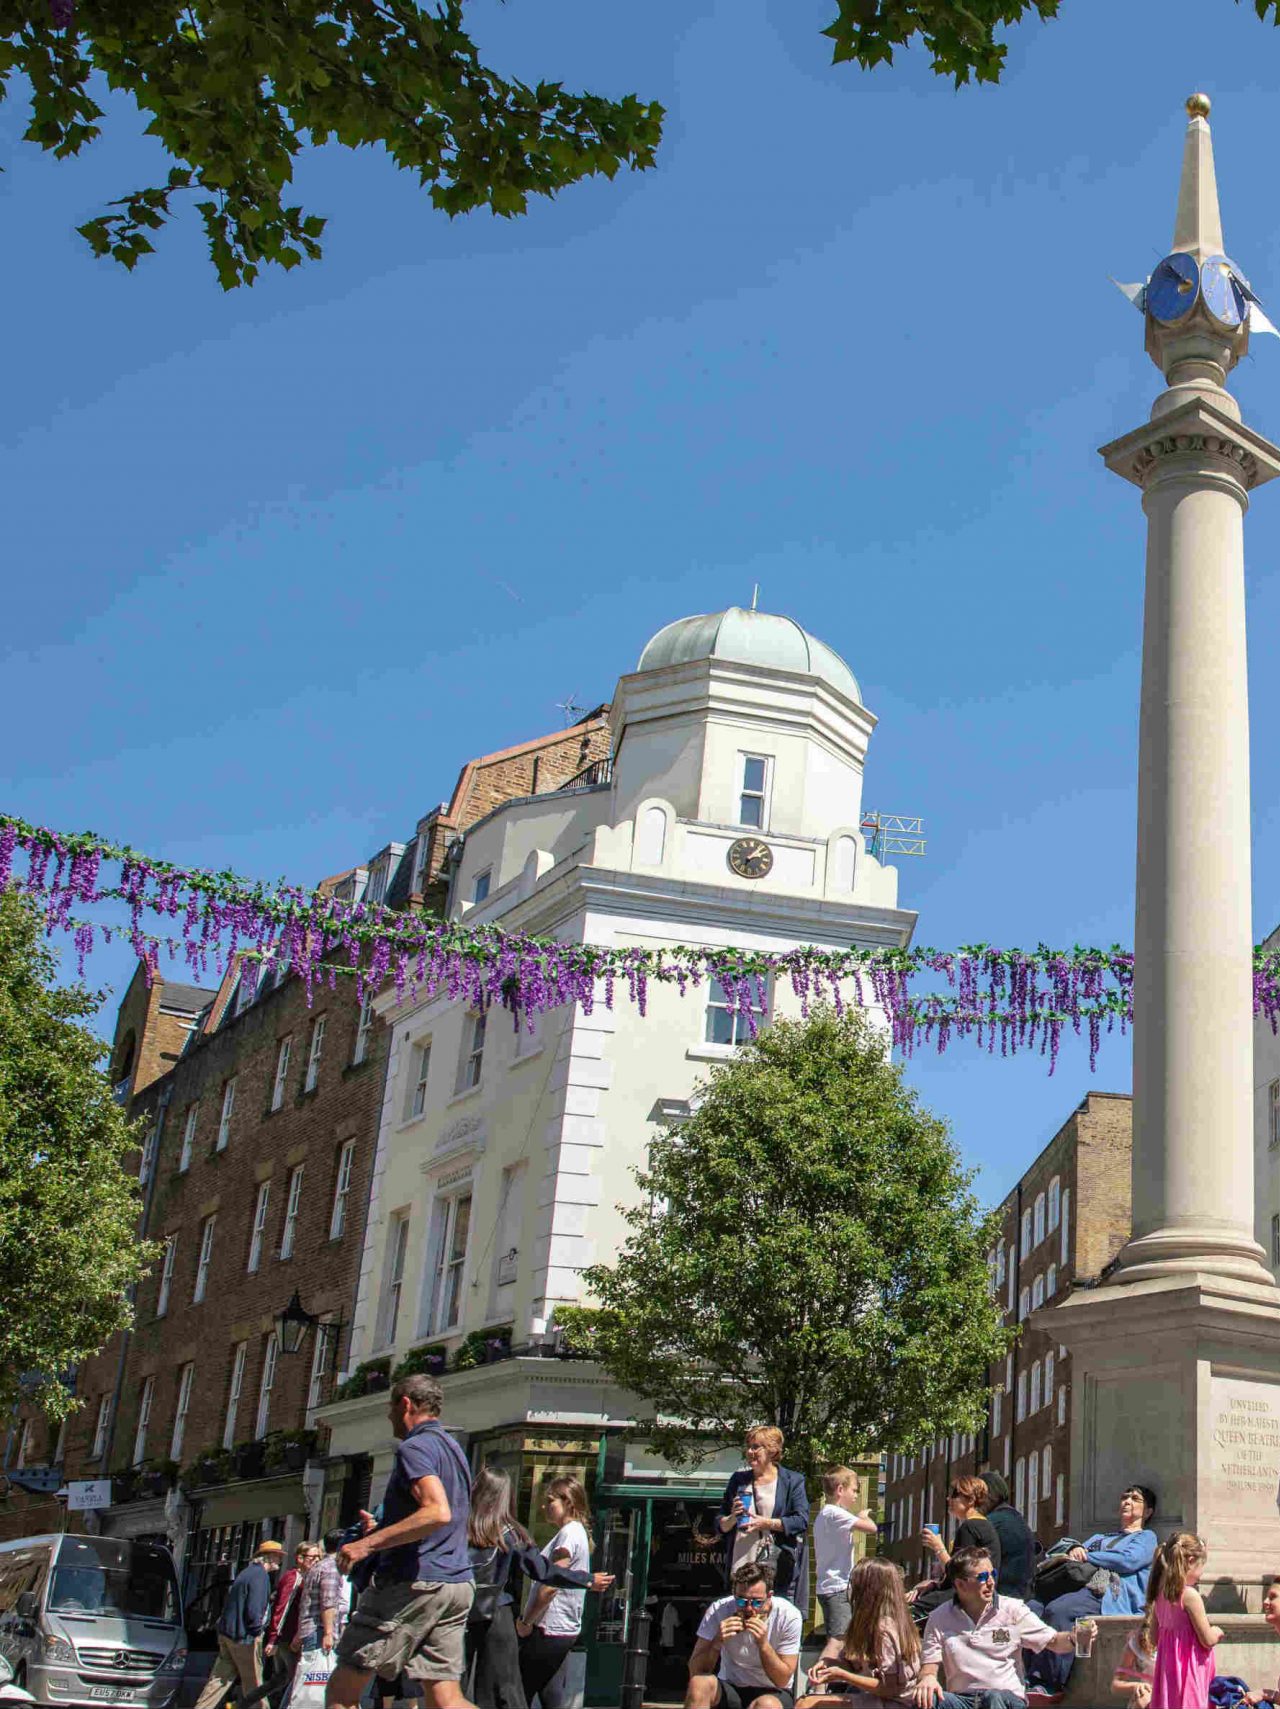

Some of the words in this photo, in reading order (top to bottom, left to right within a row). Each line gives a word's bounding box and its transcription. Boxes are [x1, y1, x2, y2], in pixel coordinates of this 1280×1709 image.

[1214, 1429, 1246, 1449] QUEEN
[1222, 1463, 1279, 1478] NETHERLANDS
[678, 1553, 707, 1564] MILES
